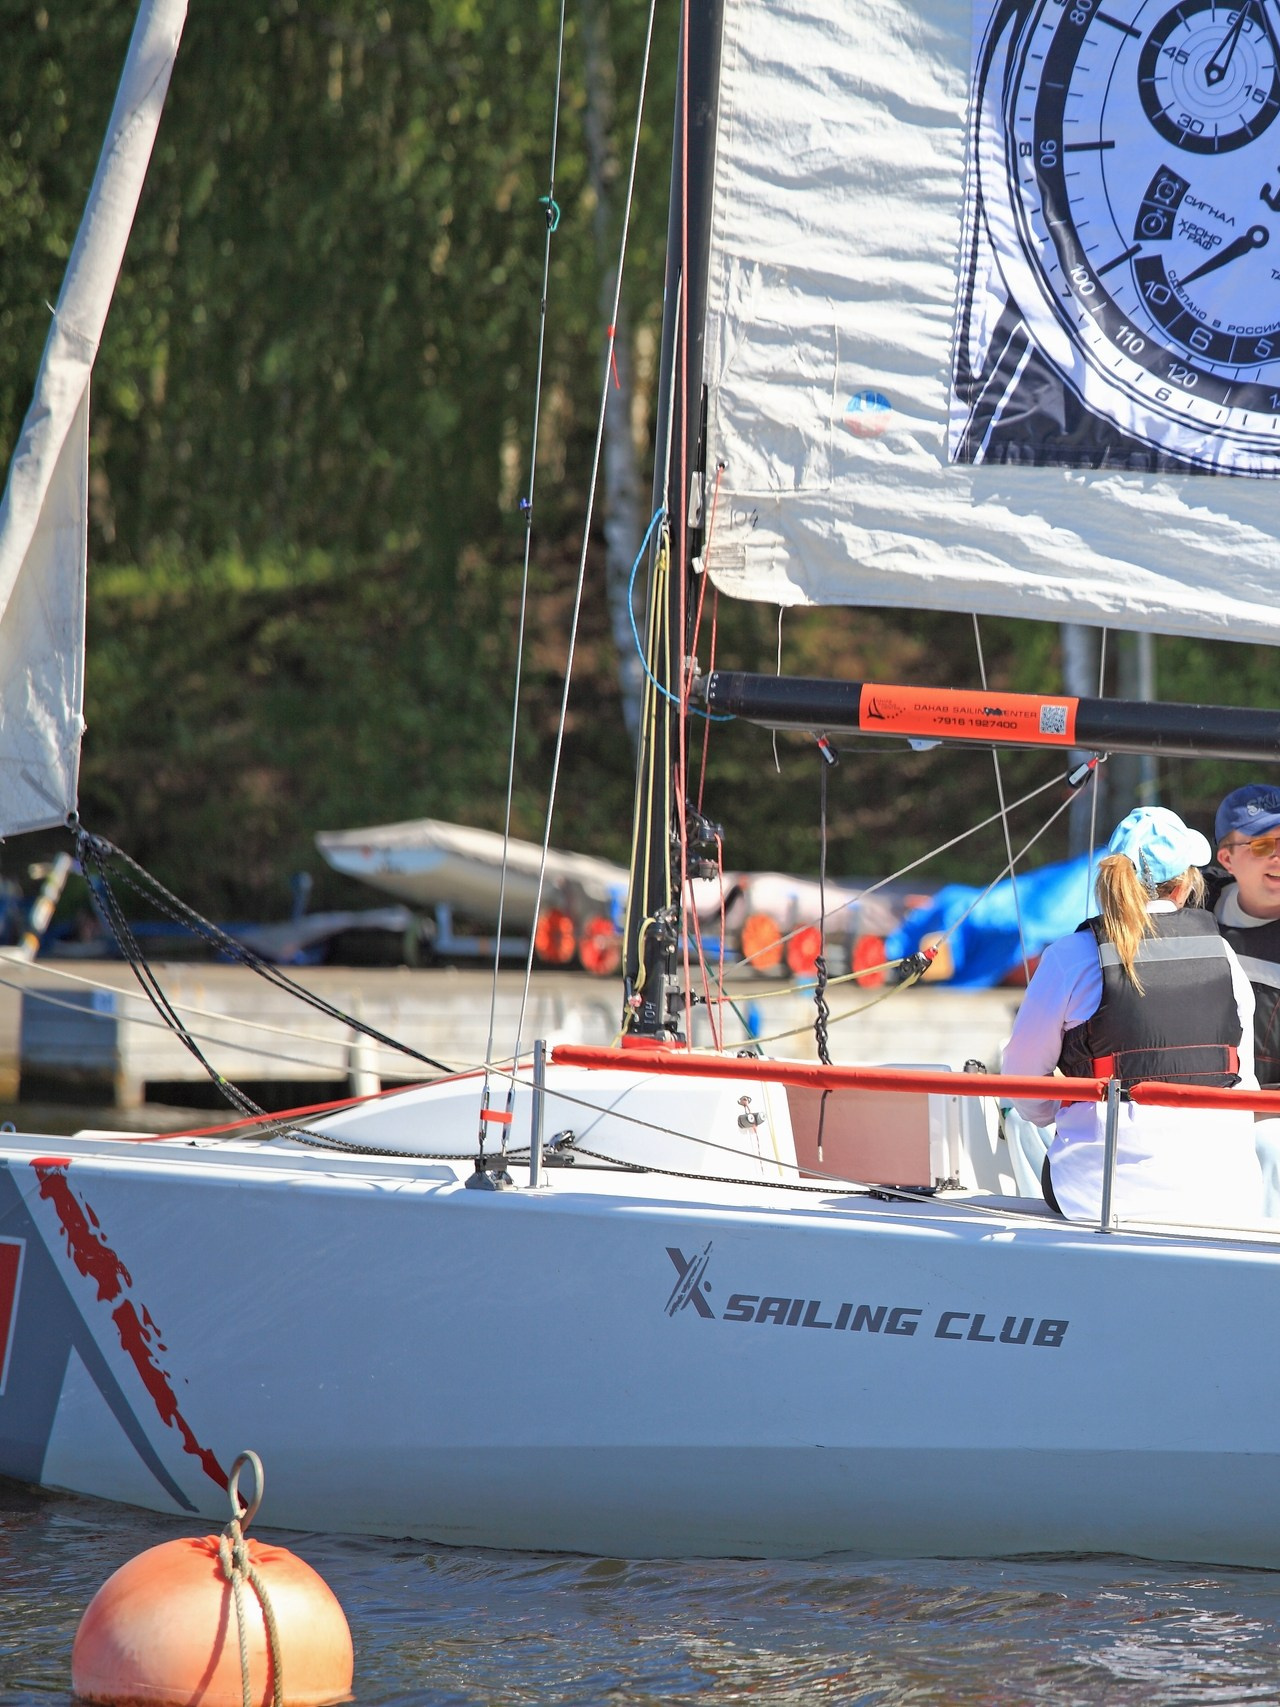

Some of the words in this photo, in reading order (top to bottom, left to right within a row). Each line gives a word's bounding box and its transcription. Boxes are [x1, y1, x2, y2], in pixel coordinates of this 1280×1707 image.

[1069, 0, 1093, 26] 80
[1226, 11, 1254, 33] 60
[1163, 46, 1191, 66] 45
[1244, 84, 1268, 104] 15
[1177, 112, 1205, 135] 30
[1039, 139, 1057, 169] 90
[1184, 194, 1236, 227] СИГНАЛ
[1069, 263, 1097, 297] 100
[1144, 280, 1172, 306] 10
[1167, 269, 1208, 320] СДЕЛАНО
[1212, 319, 1222, 329] В
[1115, 324, 1145, 354] 110
[1189, 327, 1213, 351] 6
[1254, 337, 1275, 358] 5
[1166, 362, 1199, 388] 120
[913, 704, 949, 713] DAHAB
[953, 706, 992, 717] SAILIN
[994, 709, 1037, 718] ENTER
[969, 719, 1018, 730] 1927400
[722, 1293, 922, 1337] SAILING
[934, 1310, 1070, 1348] CLUB
